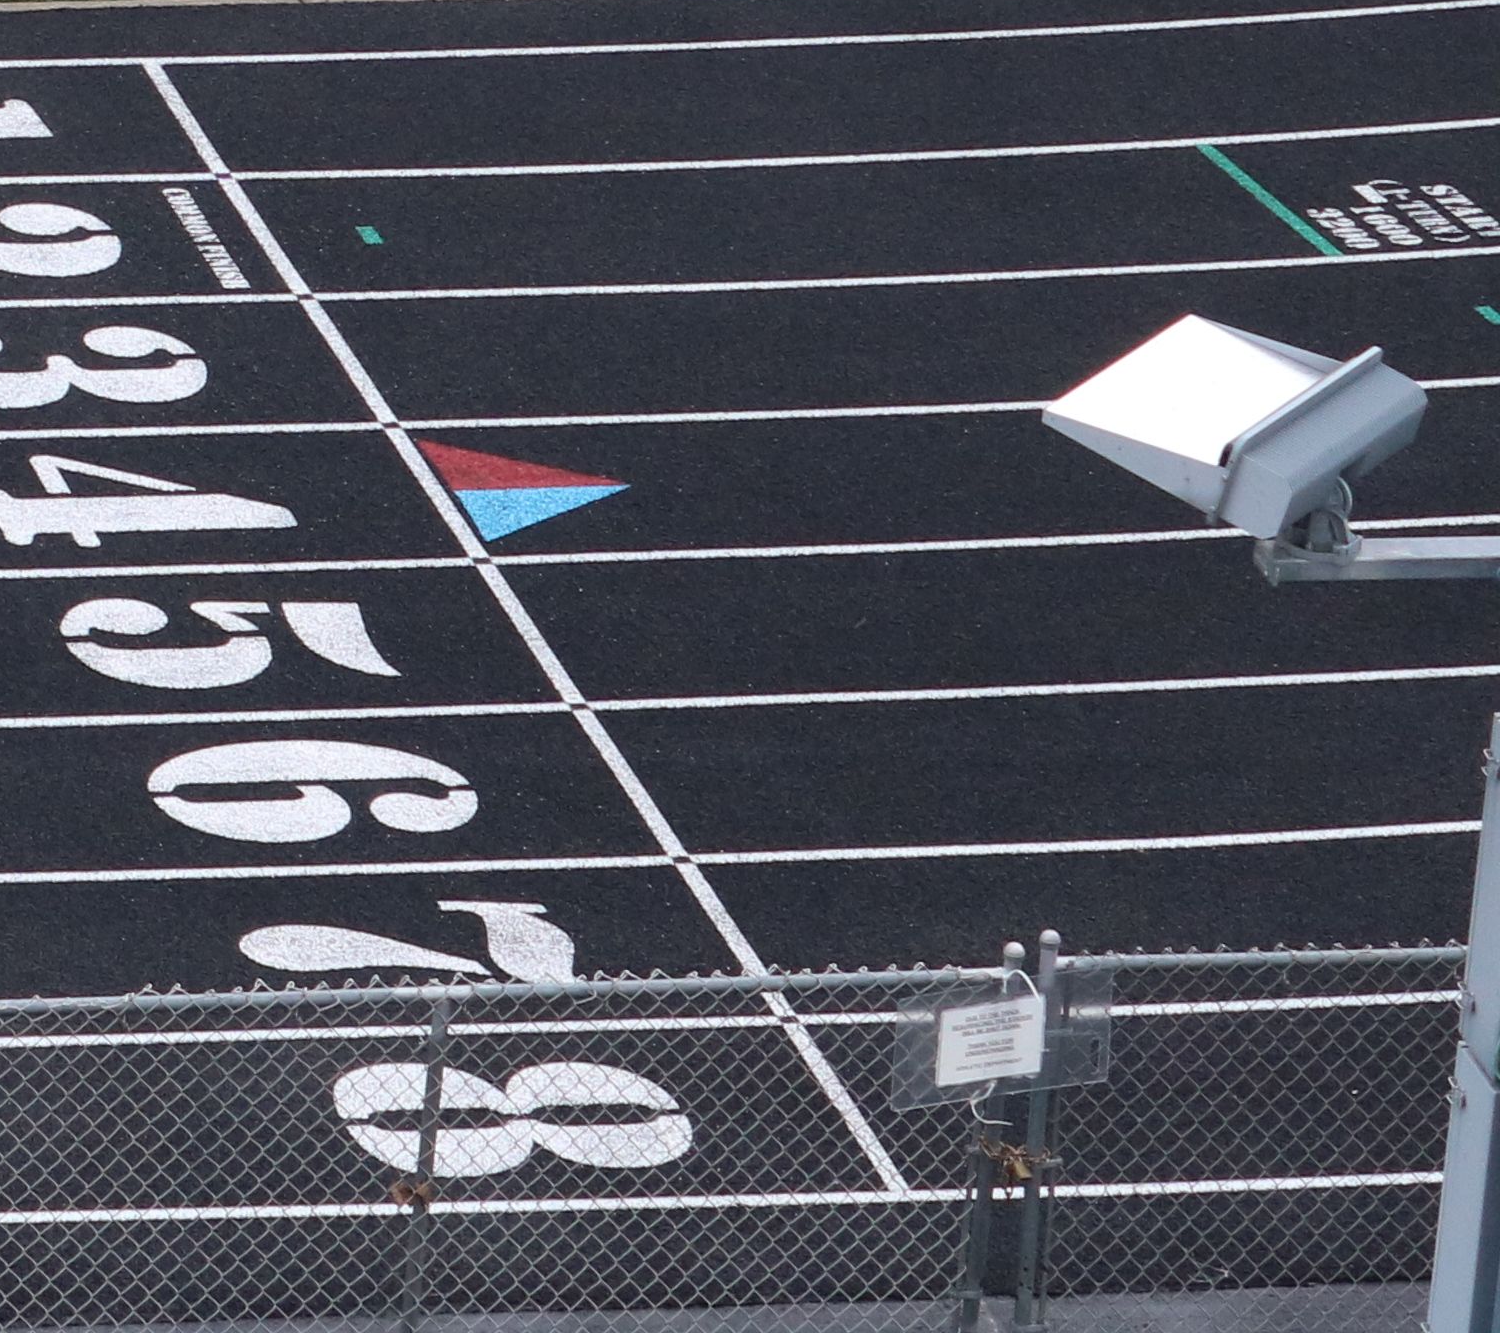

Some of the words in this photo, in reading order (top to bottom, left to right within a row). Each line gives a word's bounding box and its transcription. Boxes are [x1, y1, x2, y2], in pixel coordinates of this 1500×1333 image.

[162, 188, 220, 243] COMMON
[197, 244, 251, 289] FINISH
[1306, 208, 1380, 249] 3200
[1350, 206, 1423, 246] 1600
[58, 597, 402, 690] 5
[146, 740, 479, 845] 6
[238, 899, 575, 984] 7
[332, 1061, 695, 1179] 8
